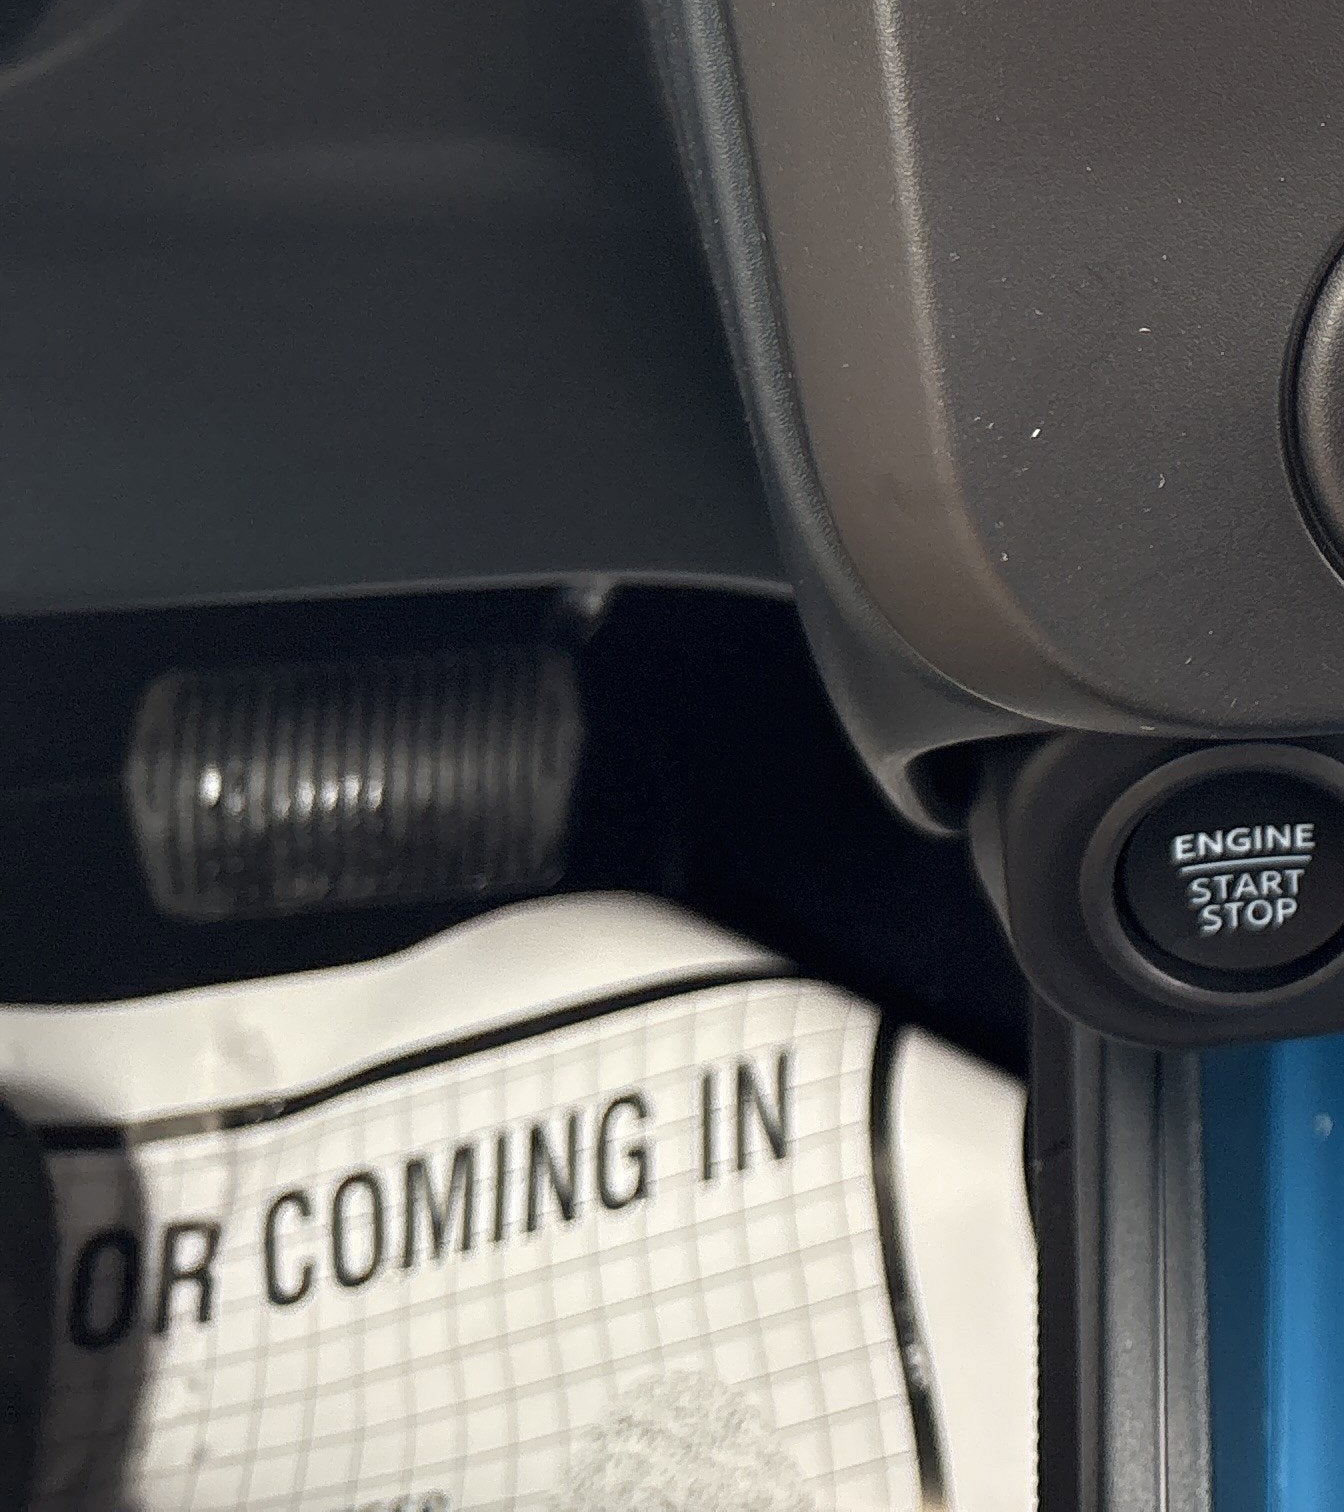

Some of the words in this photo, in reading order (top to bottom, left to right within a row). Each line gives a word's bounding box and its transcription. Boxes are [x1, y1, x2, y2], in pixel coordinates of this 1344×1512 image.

[1172, 822, 1315, 862] ENGINE
[1188, 868, 1305, 907] START
[1200, 898, 1298, 936] STOP
[262, 1090, 652, 1308] COMING
[697, 1051, 800, 1184] IN
